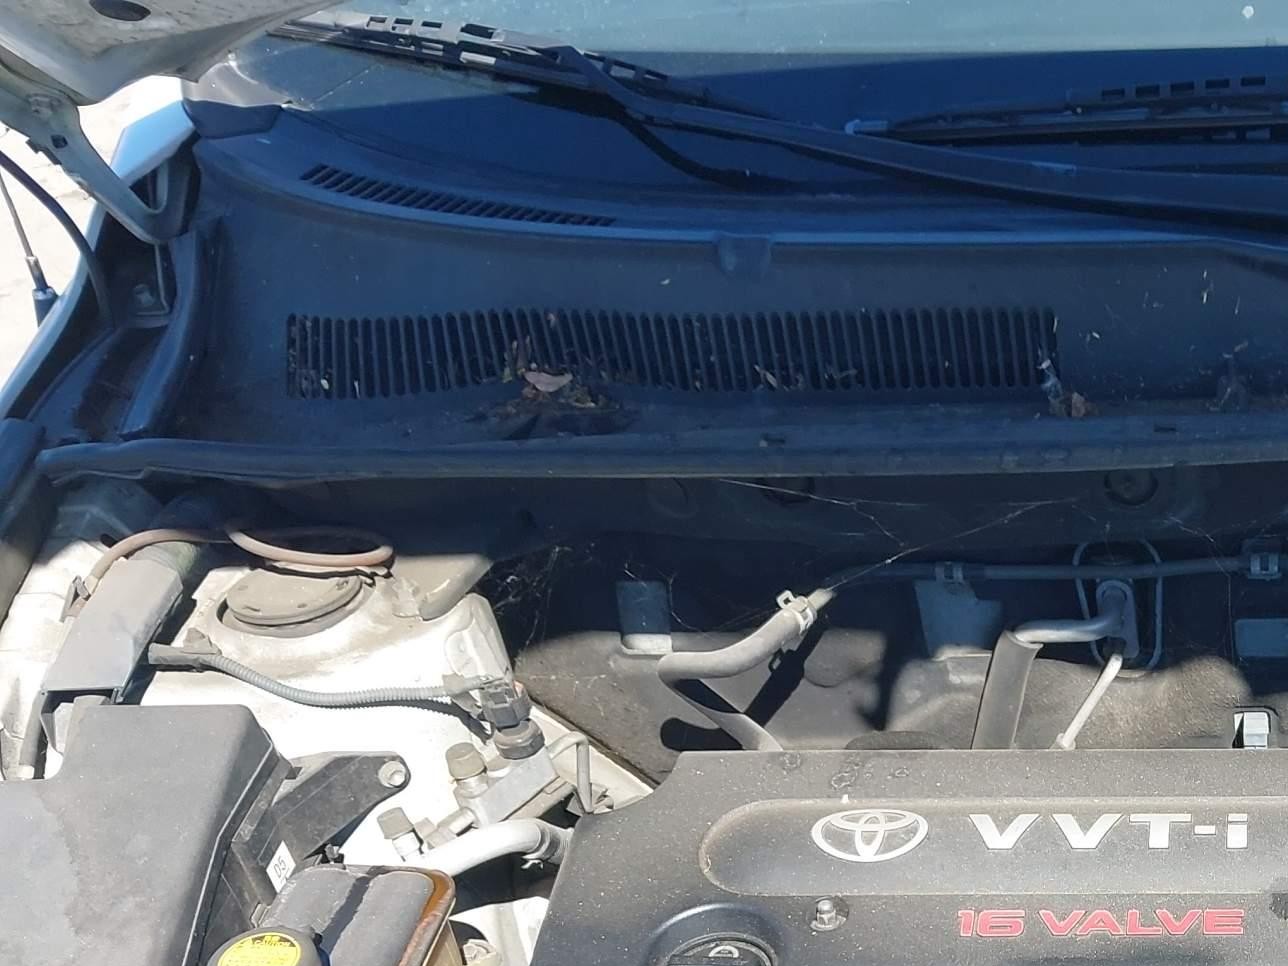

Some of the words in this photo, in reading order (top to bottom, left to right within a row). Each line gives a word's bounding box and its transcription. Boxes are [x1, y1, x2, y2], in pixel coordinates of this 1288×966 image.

[968, 813, 1248, 850] VVT-i
[957, 909, 1026, 936] 16
[1037, 908, 1245, 936] VALVE
